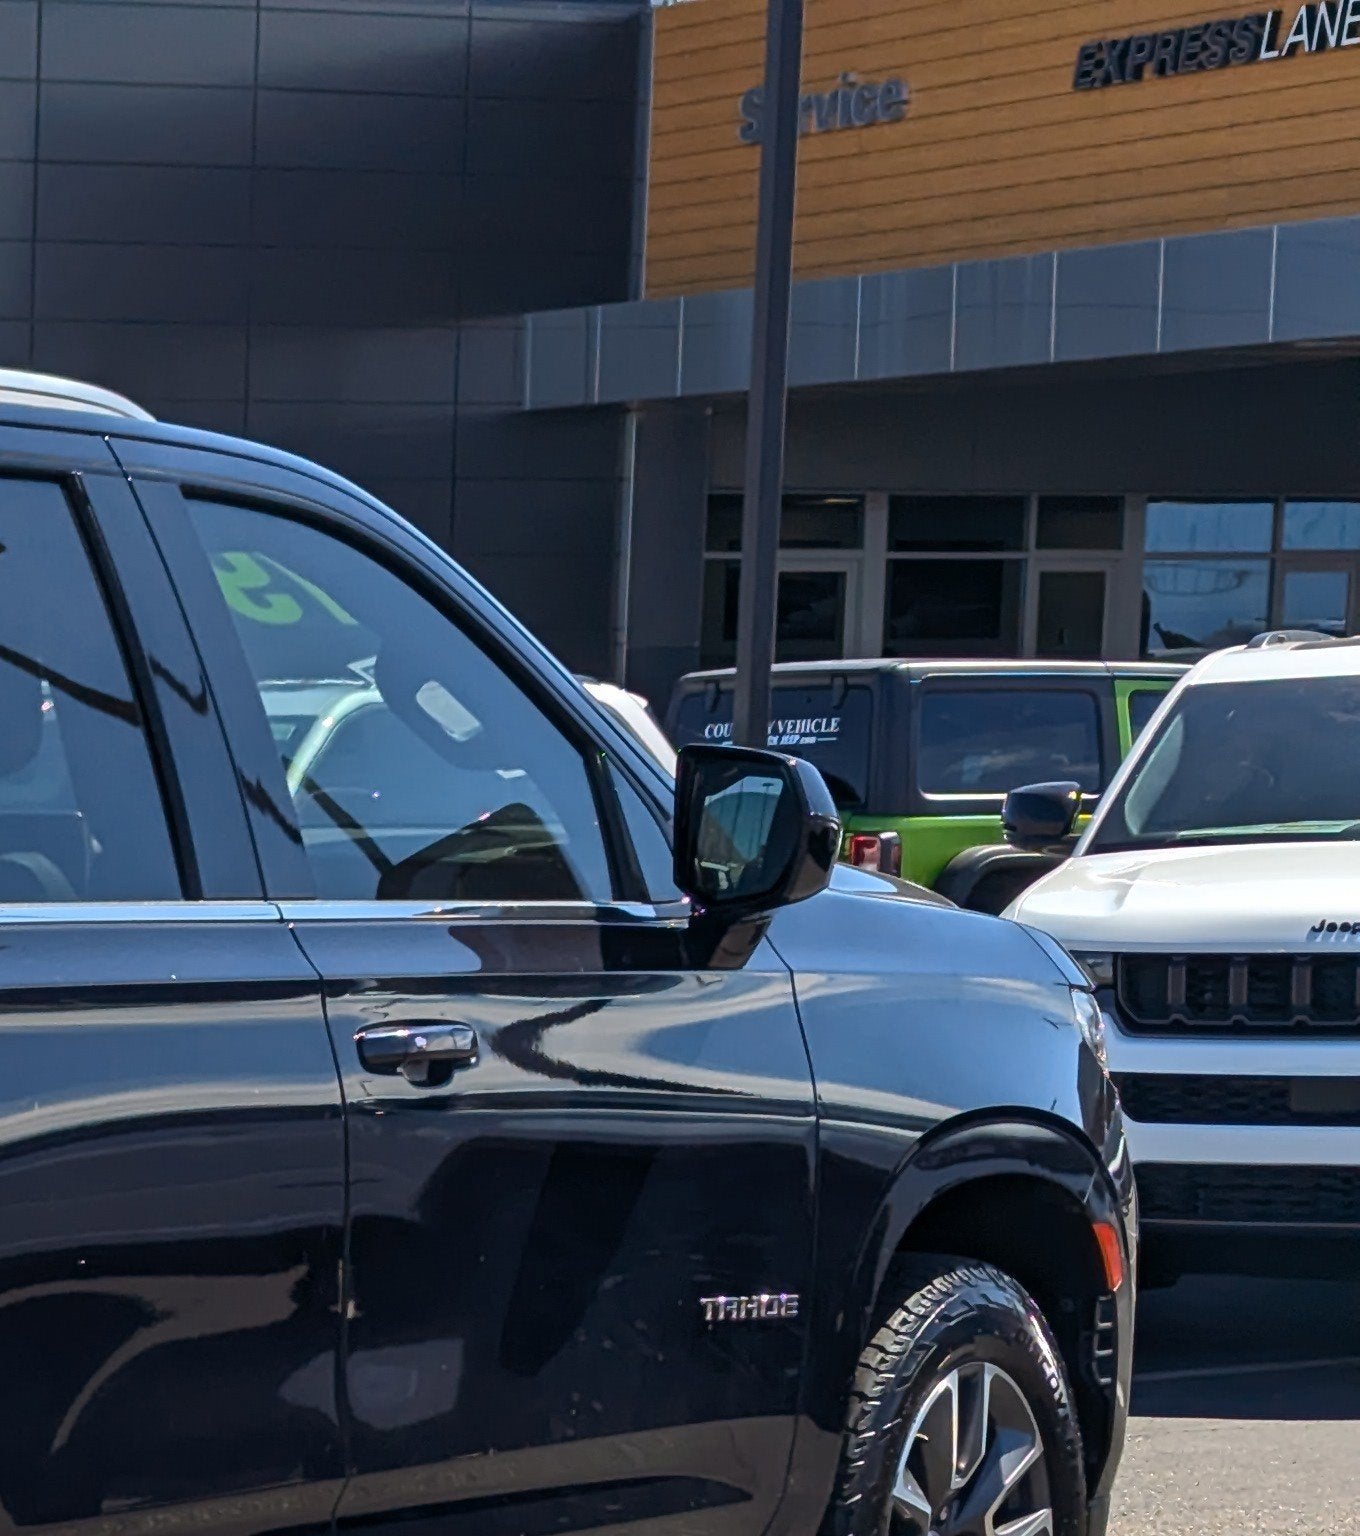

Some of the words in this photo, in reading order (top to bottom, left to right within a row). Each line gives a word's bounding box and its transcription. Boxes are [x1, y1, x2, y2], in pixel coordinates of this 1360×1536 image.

[739, 71, 909, 142] Srvice
[777, 717, 841, 734] VEHICLE
[700, 1293, 799, 1322] TAHOE
